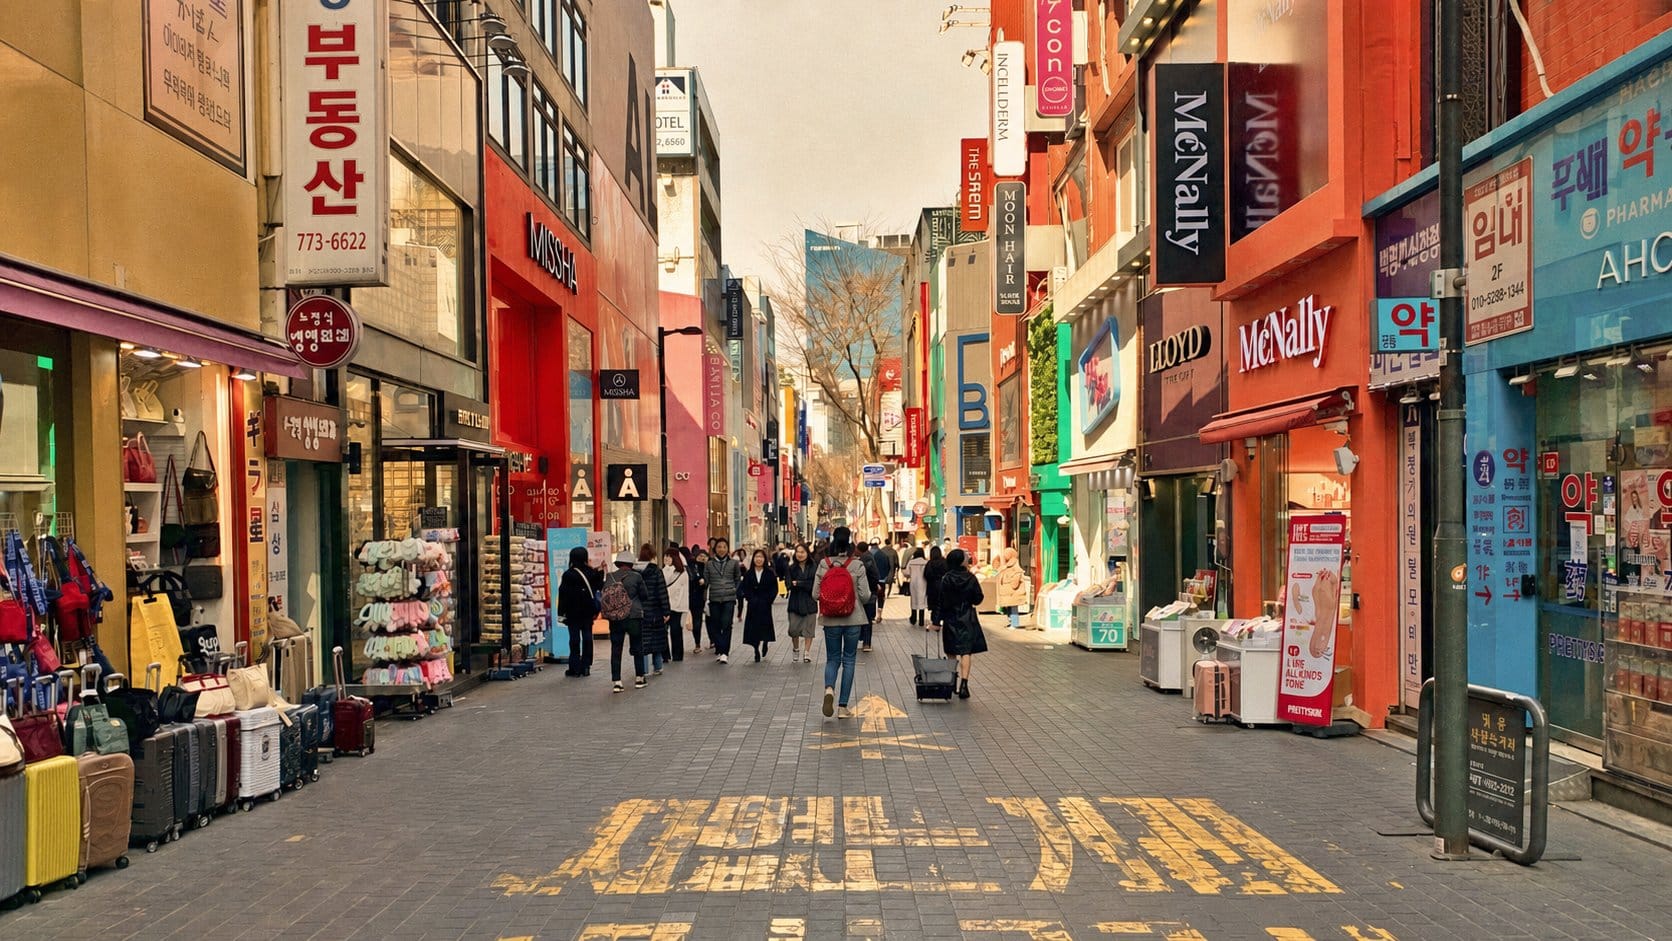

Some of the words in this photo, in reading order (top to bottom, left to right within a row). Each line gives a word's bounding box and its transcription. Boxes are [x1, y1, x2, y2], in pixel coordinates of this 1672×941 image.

[303, 24, 364, 215] 부동산
[997, 53, 1009, 141] INCELLDERM
[1165, 90, 1209, 255] McNally
[1004, 190, 1016, 235] MOON
[297, 231, 367, 251] 773-6622
[529, 212, 578, 295] MISSHA
[1004, 242, 1016, 285] HAIR
[1491, 263, 1504, 282] 2F
[1239, 294, 1333, 373] McNally
[1391, 302, 1435, 347] 약
[1149, 326, 1207, 374] LLOYD
[1099, 629, 1118, 643] 70
